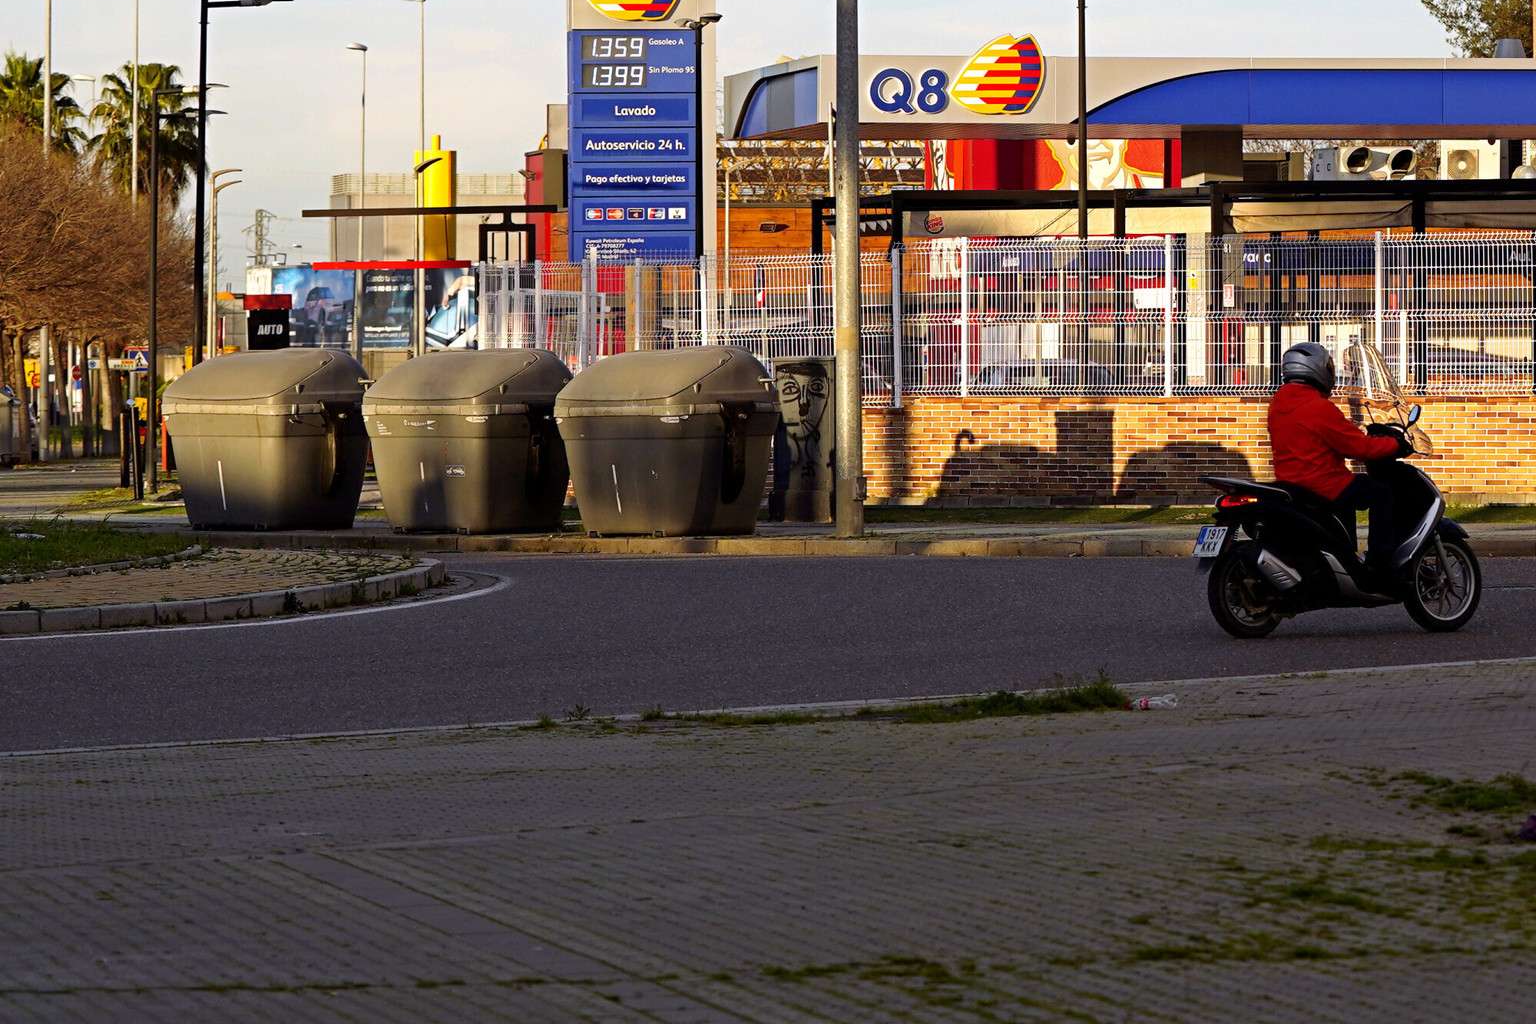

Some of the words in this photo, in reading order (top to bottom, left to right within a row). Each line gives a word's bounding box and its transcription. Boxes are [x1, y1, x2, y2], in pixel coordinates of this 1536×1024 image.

[648, 38, 677, 46] Gasoleo
[592, 38, 643, 58] 1.359
[648, 66, 660, 74] Sin
[661, 66, 683, 74] Plomo
[592, 66, 643, 86] 1.399
[870, 68, 946, 114] Q8
[614, 105, 656, 116] Lavado
[585, 140, 655, 151] Autoservicio
[658, 140, 672, 150] 24
[675, 139, 686, 150] h.
[585, 175, 607, 185] Pago
[609, 174, 643, 183] efectivo
[645, 176, 651, 184] y
[652, 175, 686, 184] tarjetas
[258, 324, 283, 335] AUTO
[1207, 529, 1226, 539] 1917
